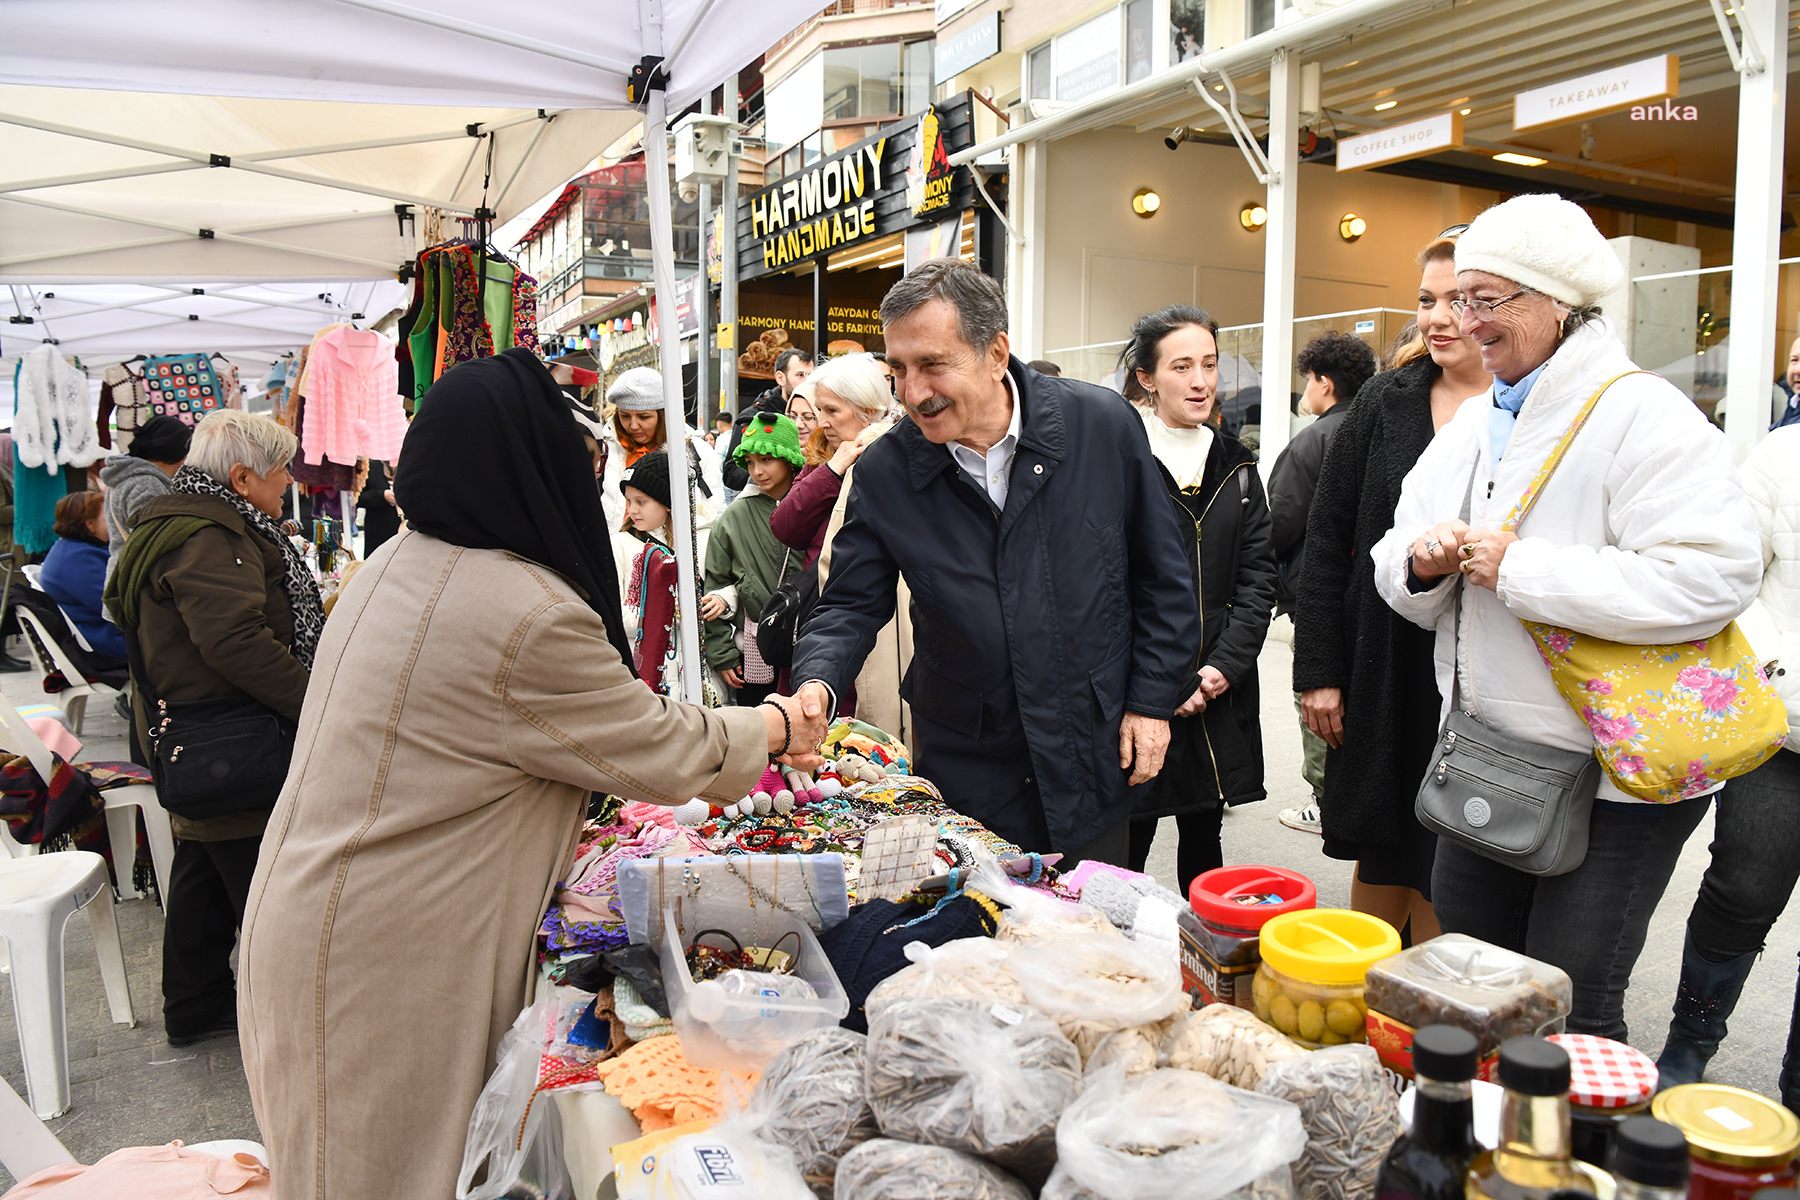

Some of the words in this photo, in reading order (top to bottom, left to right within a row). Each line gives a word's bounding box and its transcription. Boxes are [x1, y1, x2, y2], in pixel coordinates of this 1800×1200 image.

[1549, 79, 1630, 108] TAKEAWAY
[1354, 138, 1396, 156] COFFEE
[1402, 129, 1433, 144] SHOP
[751, 137, 886, 239] HARMONY
[763, 199, 875, 268] HANDMADE
[737, 315, 786, 329] HARMONY
[846, 322, 883, 335] FARKIYL
[828, 306, 869, 319] ATAYDAN
[871, 309, 882, 320] G
